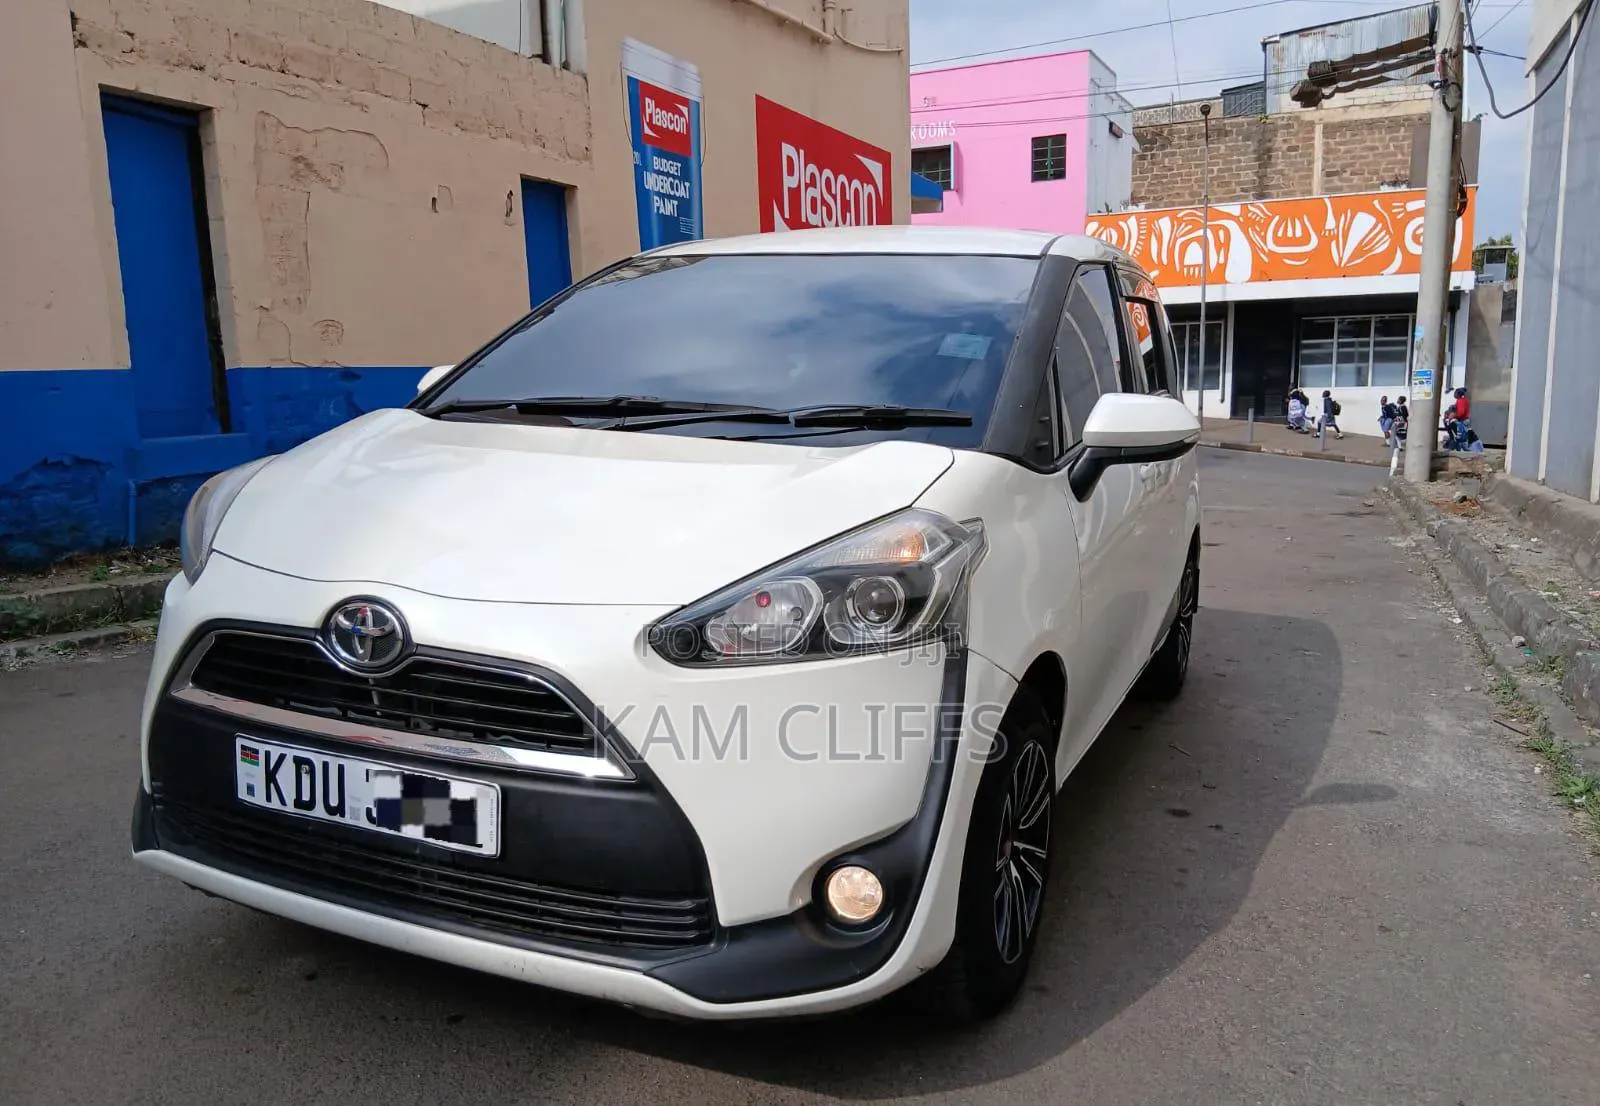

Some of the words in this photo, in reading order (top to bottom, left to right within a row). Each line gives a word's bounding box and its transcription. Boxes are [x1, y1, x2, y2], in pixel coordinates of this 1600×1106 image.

[645, 96, 687, 135] Plascon
[911, 120, 956, 140] ROOMS
[653, 156, 681, 176] BUDGET
[643, 171, 690, 199] UNDERCOAT
[781, 141, 877, 228] Plascon
[653, 196, 678, 217] PAINT
[264, 749, 346, 819] KDU
